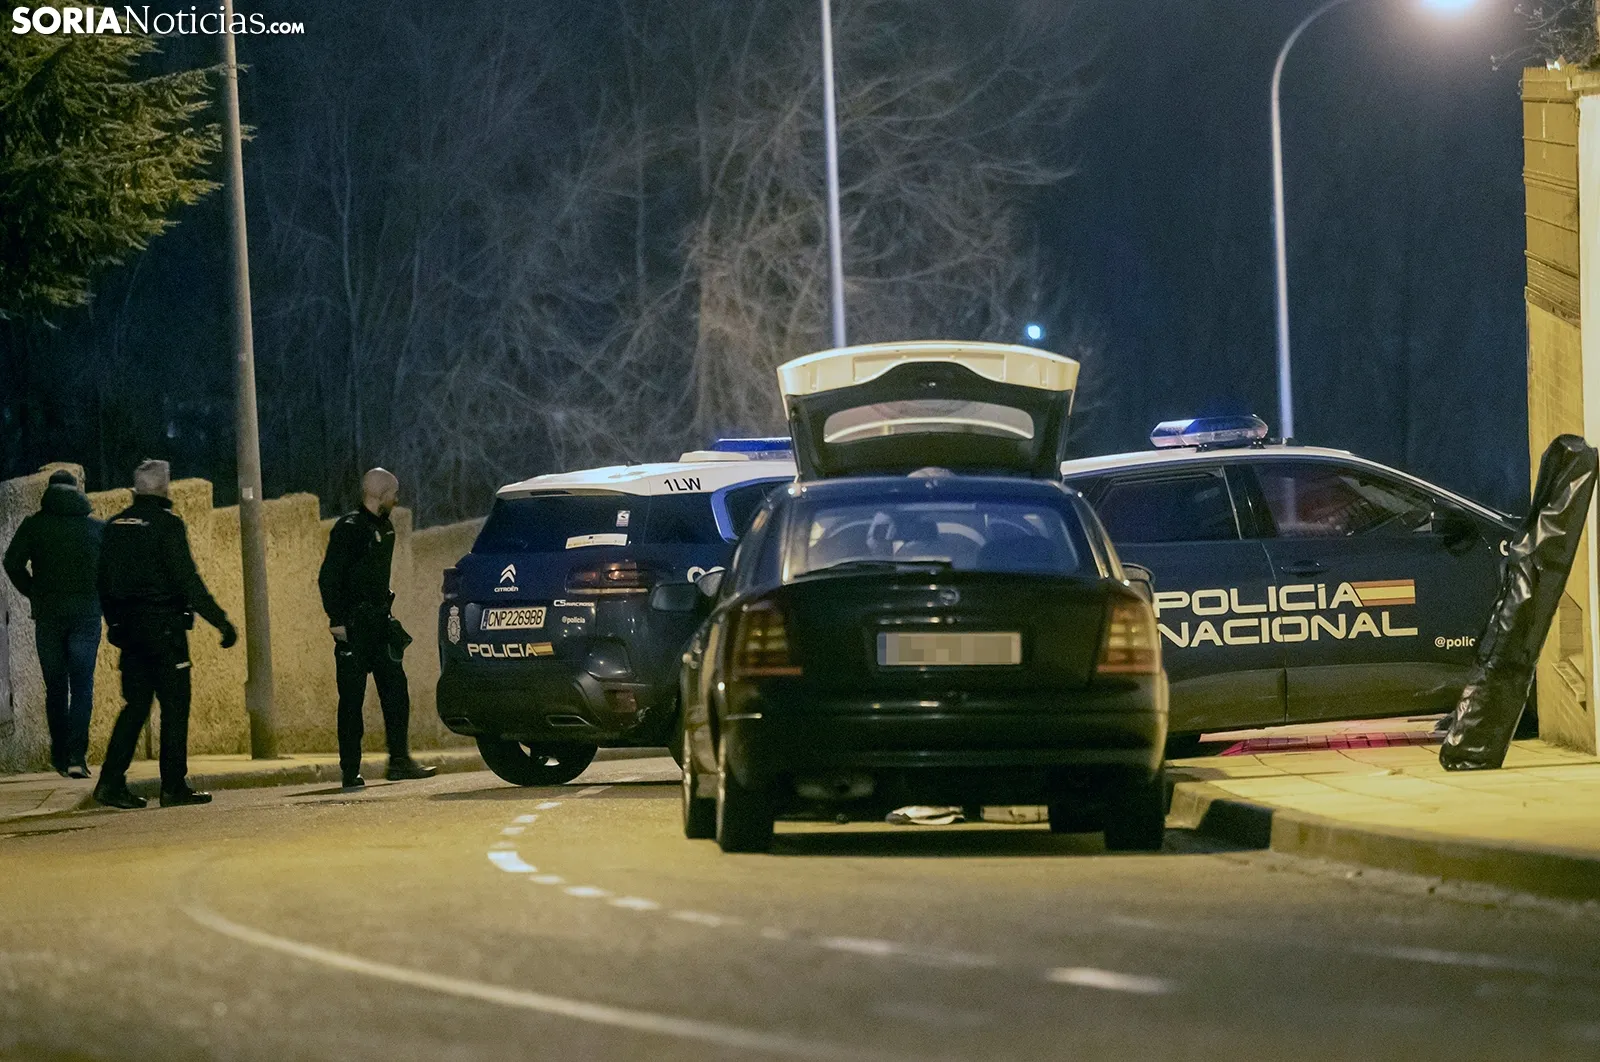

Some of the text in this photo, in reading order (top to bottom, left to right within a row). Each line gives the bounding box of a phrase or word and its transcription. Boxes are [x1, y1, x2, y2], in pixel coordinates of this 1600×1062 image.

[664, 477, 701, 492] 1LW
[488, 609, 544, 627] CNP2269BB
[1157, 611, 1418, 648] NACIONAL
[1434, 635, 1476, 650] @polic
